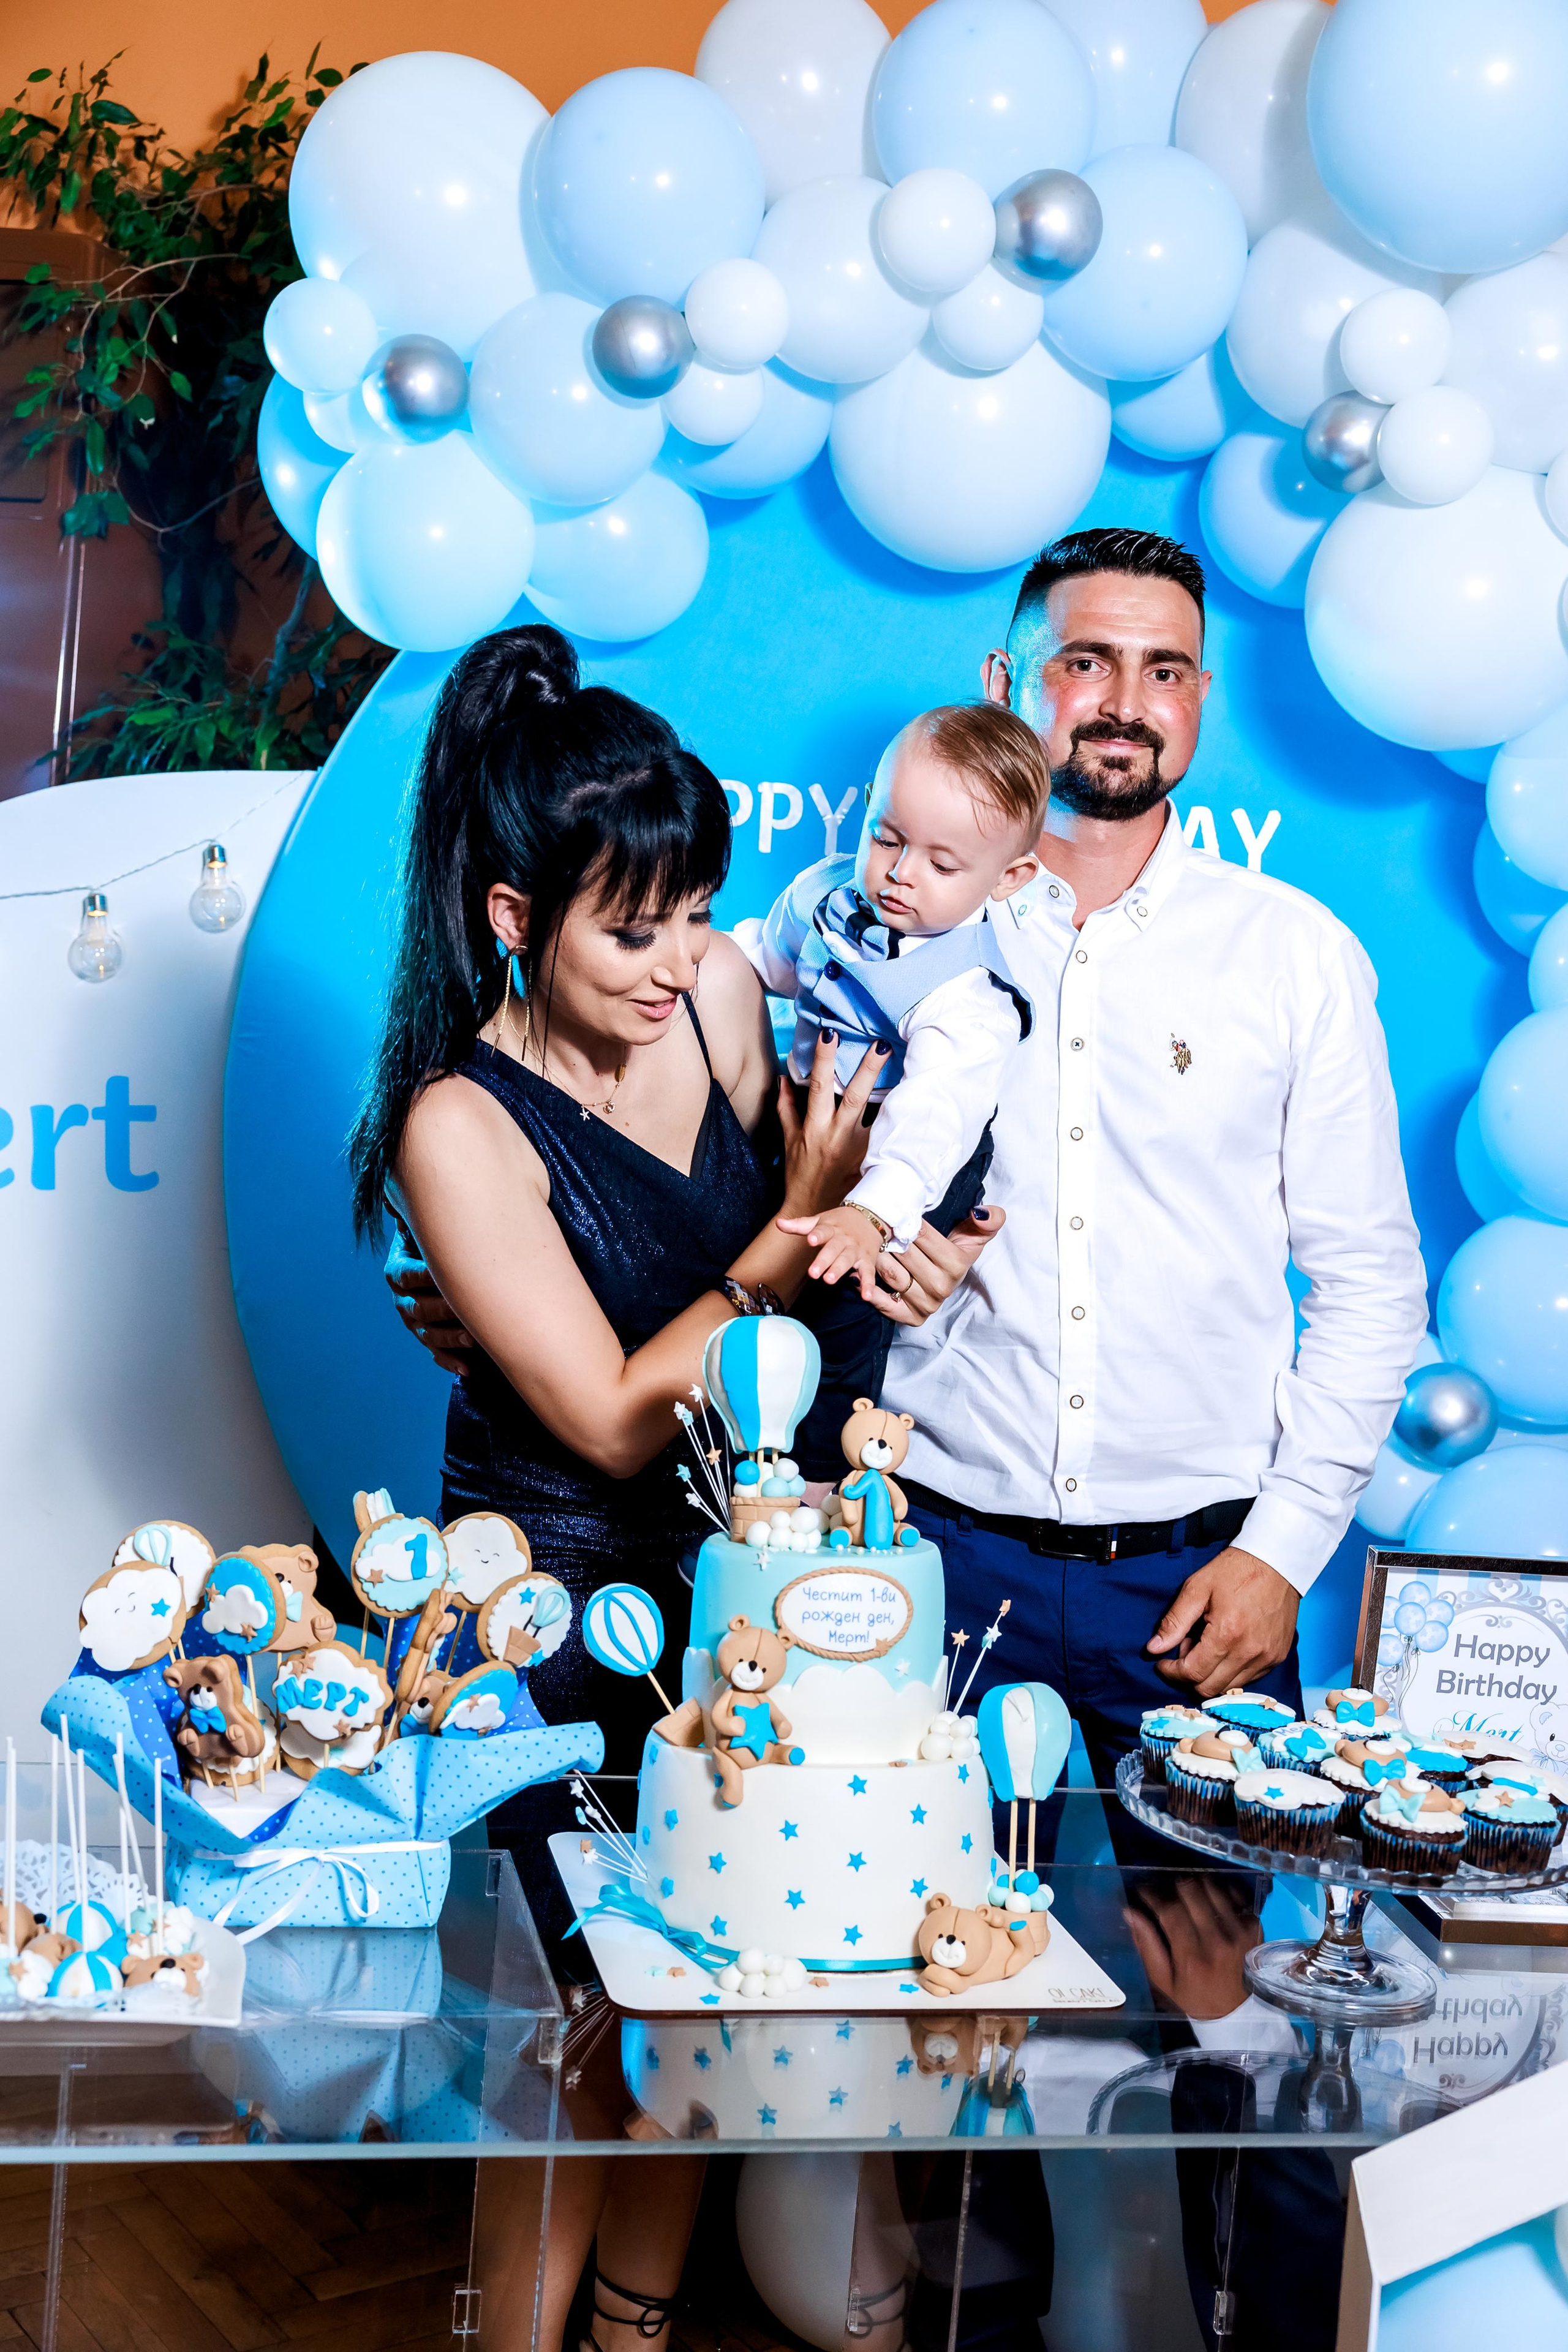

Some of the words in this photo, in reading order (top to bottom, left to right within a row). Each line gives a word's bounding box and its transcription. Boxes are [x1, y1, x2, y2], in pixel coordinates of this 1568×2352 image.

[718, 779, 858, 856] PPY
[405, 1533, 428, 1580] 1
[802, 1587, 862, 1602] Честит
[870, 1586, 897, 1603] 1-ви
[802, 1611, 861, 1626] рожден
[867, 1612, 895, 1627] ден,
[828, 1630, 870, 1646] Мерт!
[1453, 1634, 1551, 1668] Happy
[276, 1676, 370, 1717] МЕРТ
[1436, 1670, 1558, 1706] Birthday
